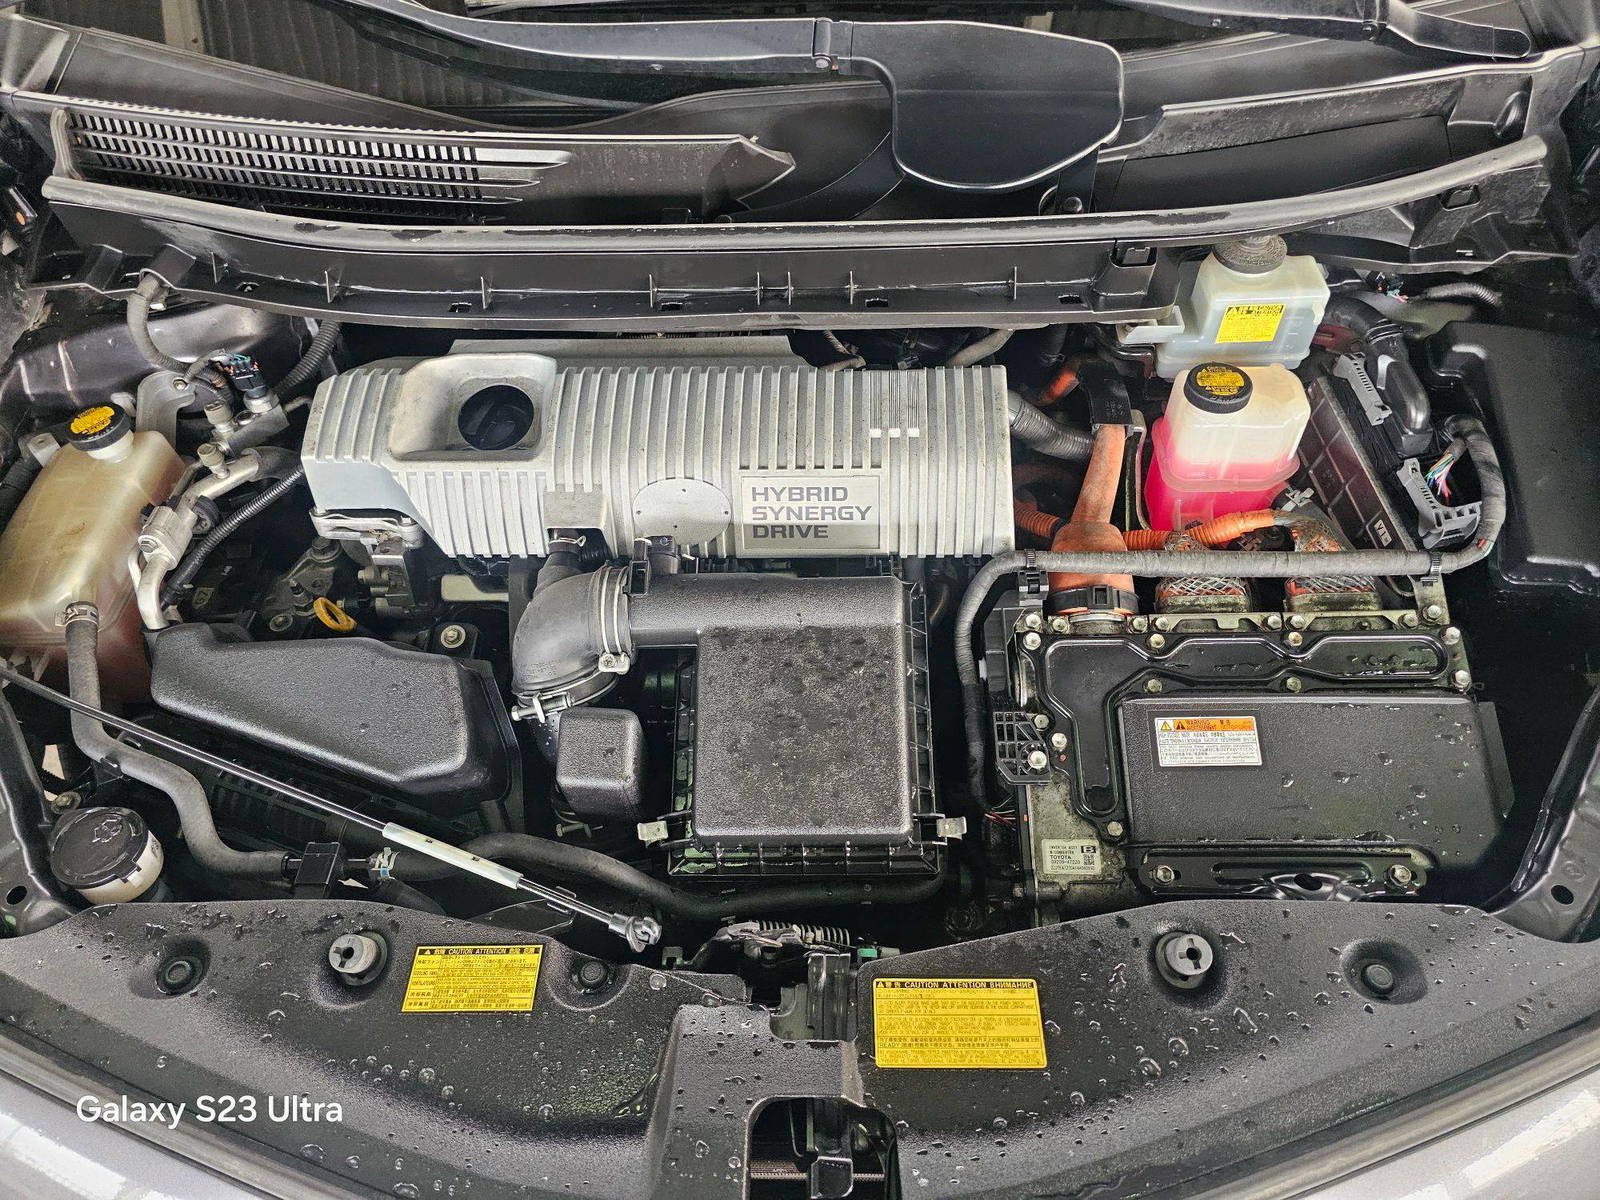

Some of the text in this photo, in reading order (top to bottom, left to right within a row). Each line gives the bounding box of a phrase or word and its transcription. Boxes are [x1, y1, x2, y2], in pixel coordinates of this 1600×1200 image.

[751, 486, 849, 502] HYBRID
[752, 505, 872, 521] SYNERGY
[752, 524, 829, 539] DRIVE
[448, 947, 474, 955] CAUTION
[475, 947, 507, 955] ATTENTION
[904, 981, 940, 989] CAUTION
[942, 981, 987, 989] ATTENTION
[989, 981, 1032, 989] ВНИМАНИЕ
